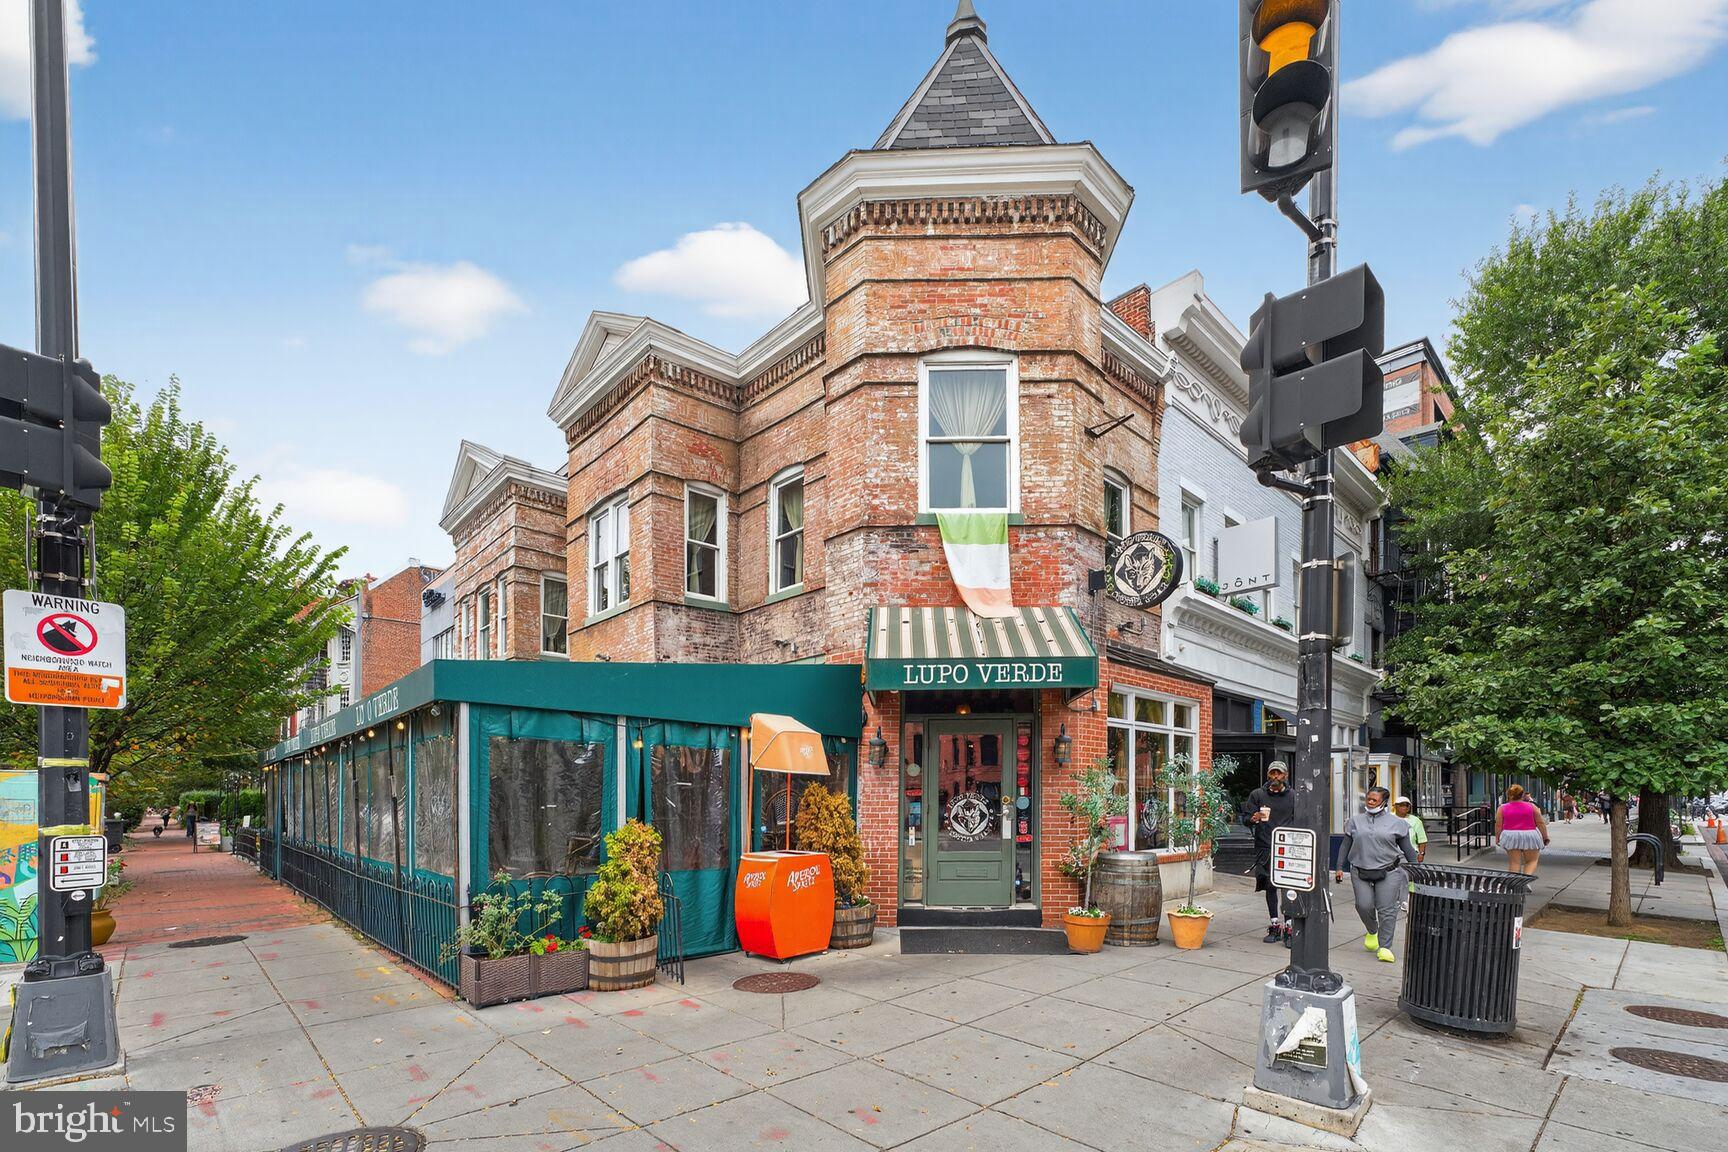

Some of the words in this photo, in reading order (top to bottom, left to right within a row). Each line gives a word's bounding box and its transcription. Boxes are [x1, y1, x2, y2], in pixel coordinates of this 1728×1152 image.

[32, 593, 100, 614] WARNING
[903, 664, 969, 684] LUPO
[976, 663, 1062, 683] VERDE
